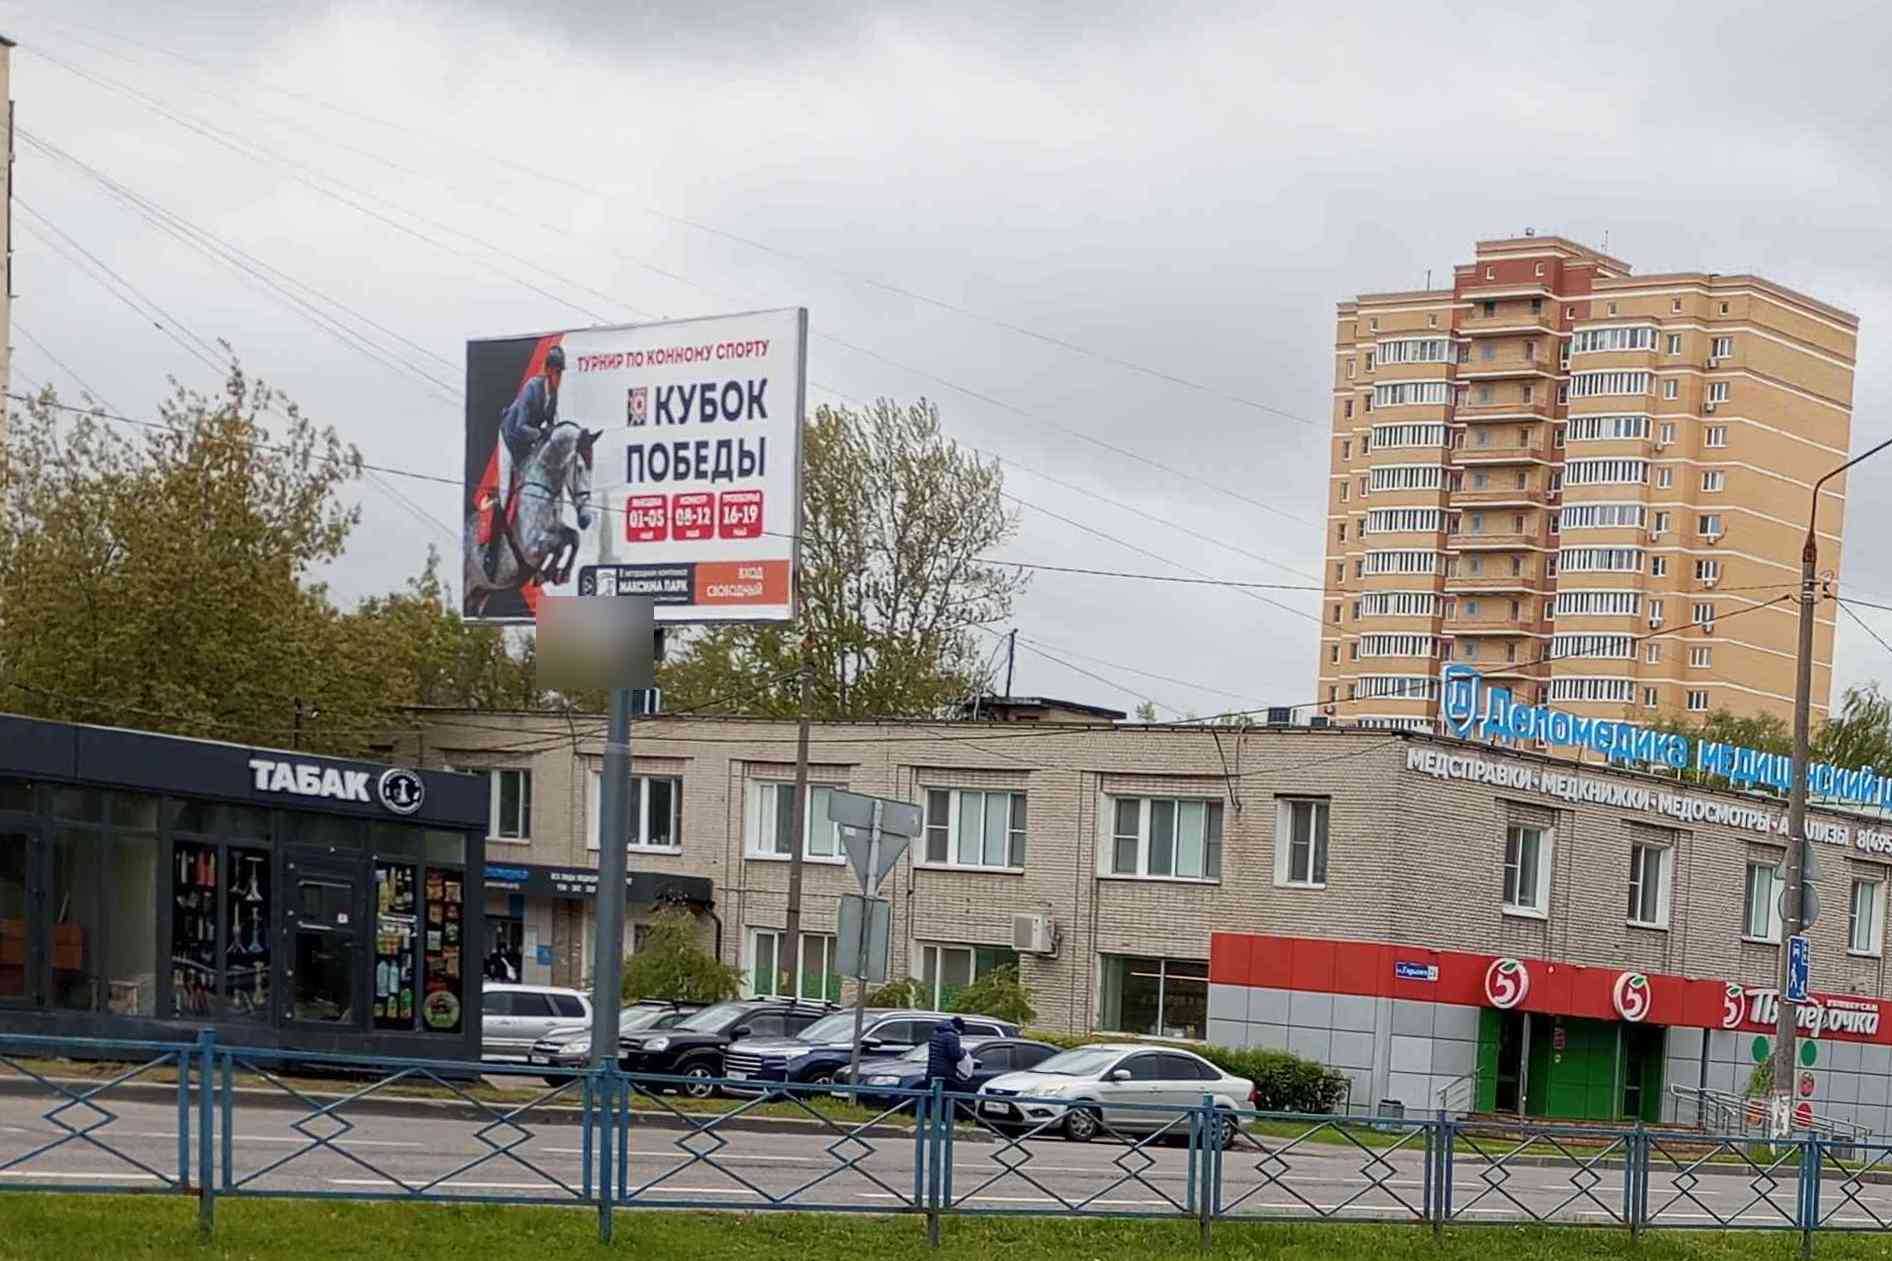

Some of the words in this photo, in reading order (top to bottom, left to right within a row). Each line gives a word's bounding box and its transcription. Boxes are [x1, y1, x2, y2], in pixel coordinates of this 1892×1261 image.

[577, 353, 624, 373] ТУРНИР
[627, 352, 644, 368] ПО
[647, 344, 712, 366] КОННОМУ
[716, 339, 769, 361] СПОРТУ
[655, 378, 768, 426] КУБОК
[626, 437, 766, 485] ПОБЕДЫ
[629, 509, 665, 528] 01-05
[675, 507, 711, 527] 08-12
[723, 504, 759, 525] 16-19
[248, 759, 372, 802] ТАБАК
[1697, 739, 1876, 804] МЕДИЦНСКИЙ
